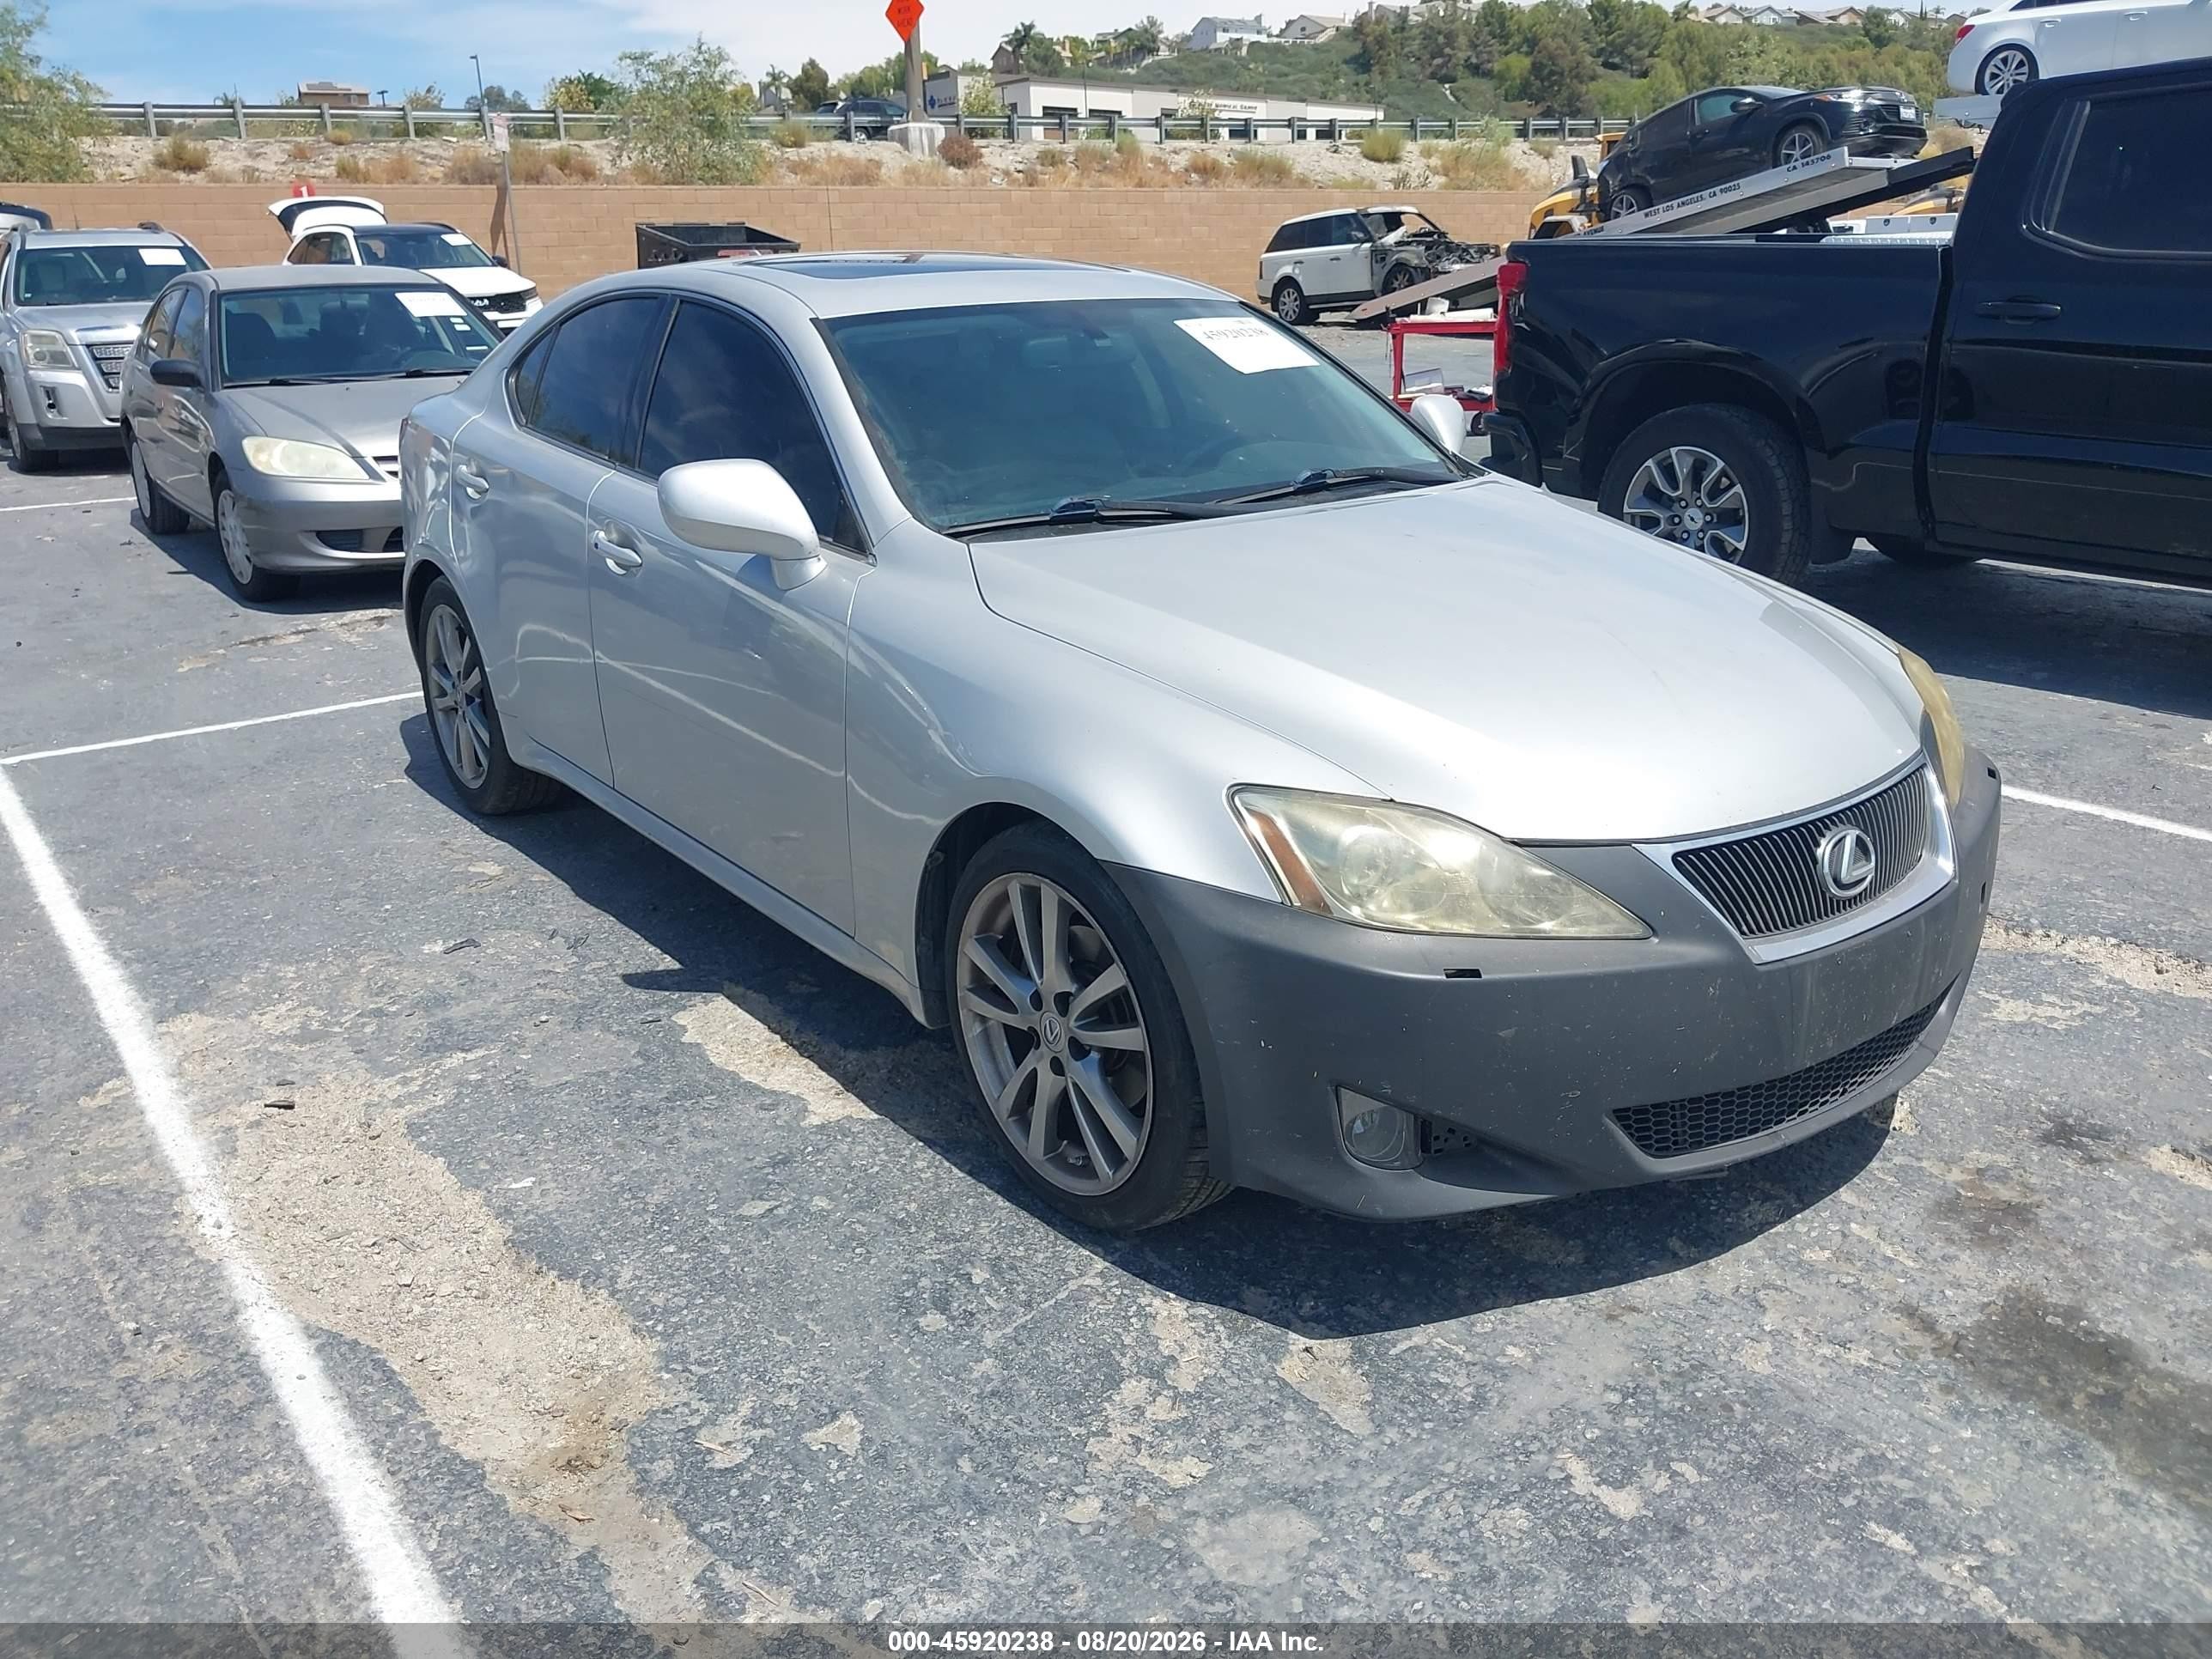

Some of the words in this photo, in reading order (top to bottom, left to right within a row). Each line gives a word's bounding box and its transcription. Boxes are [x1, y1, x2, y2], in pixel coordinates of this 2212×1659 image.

[1644, 209, 1661, 219] WEST
[1662, 204, 1674, 213] LOS
[1719, 182, 1741, 195] 90025
